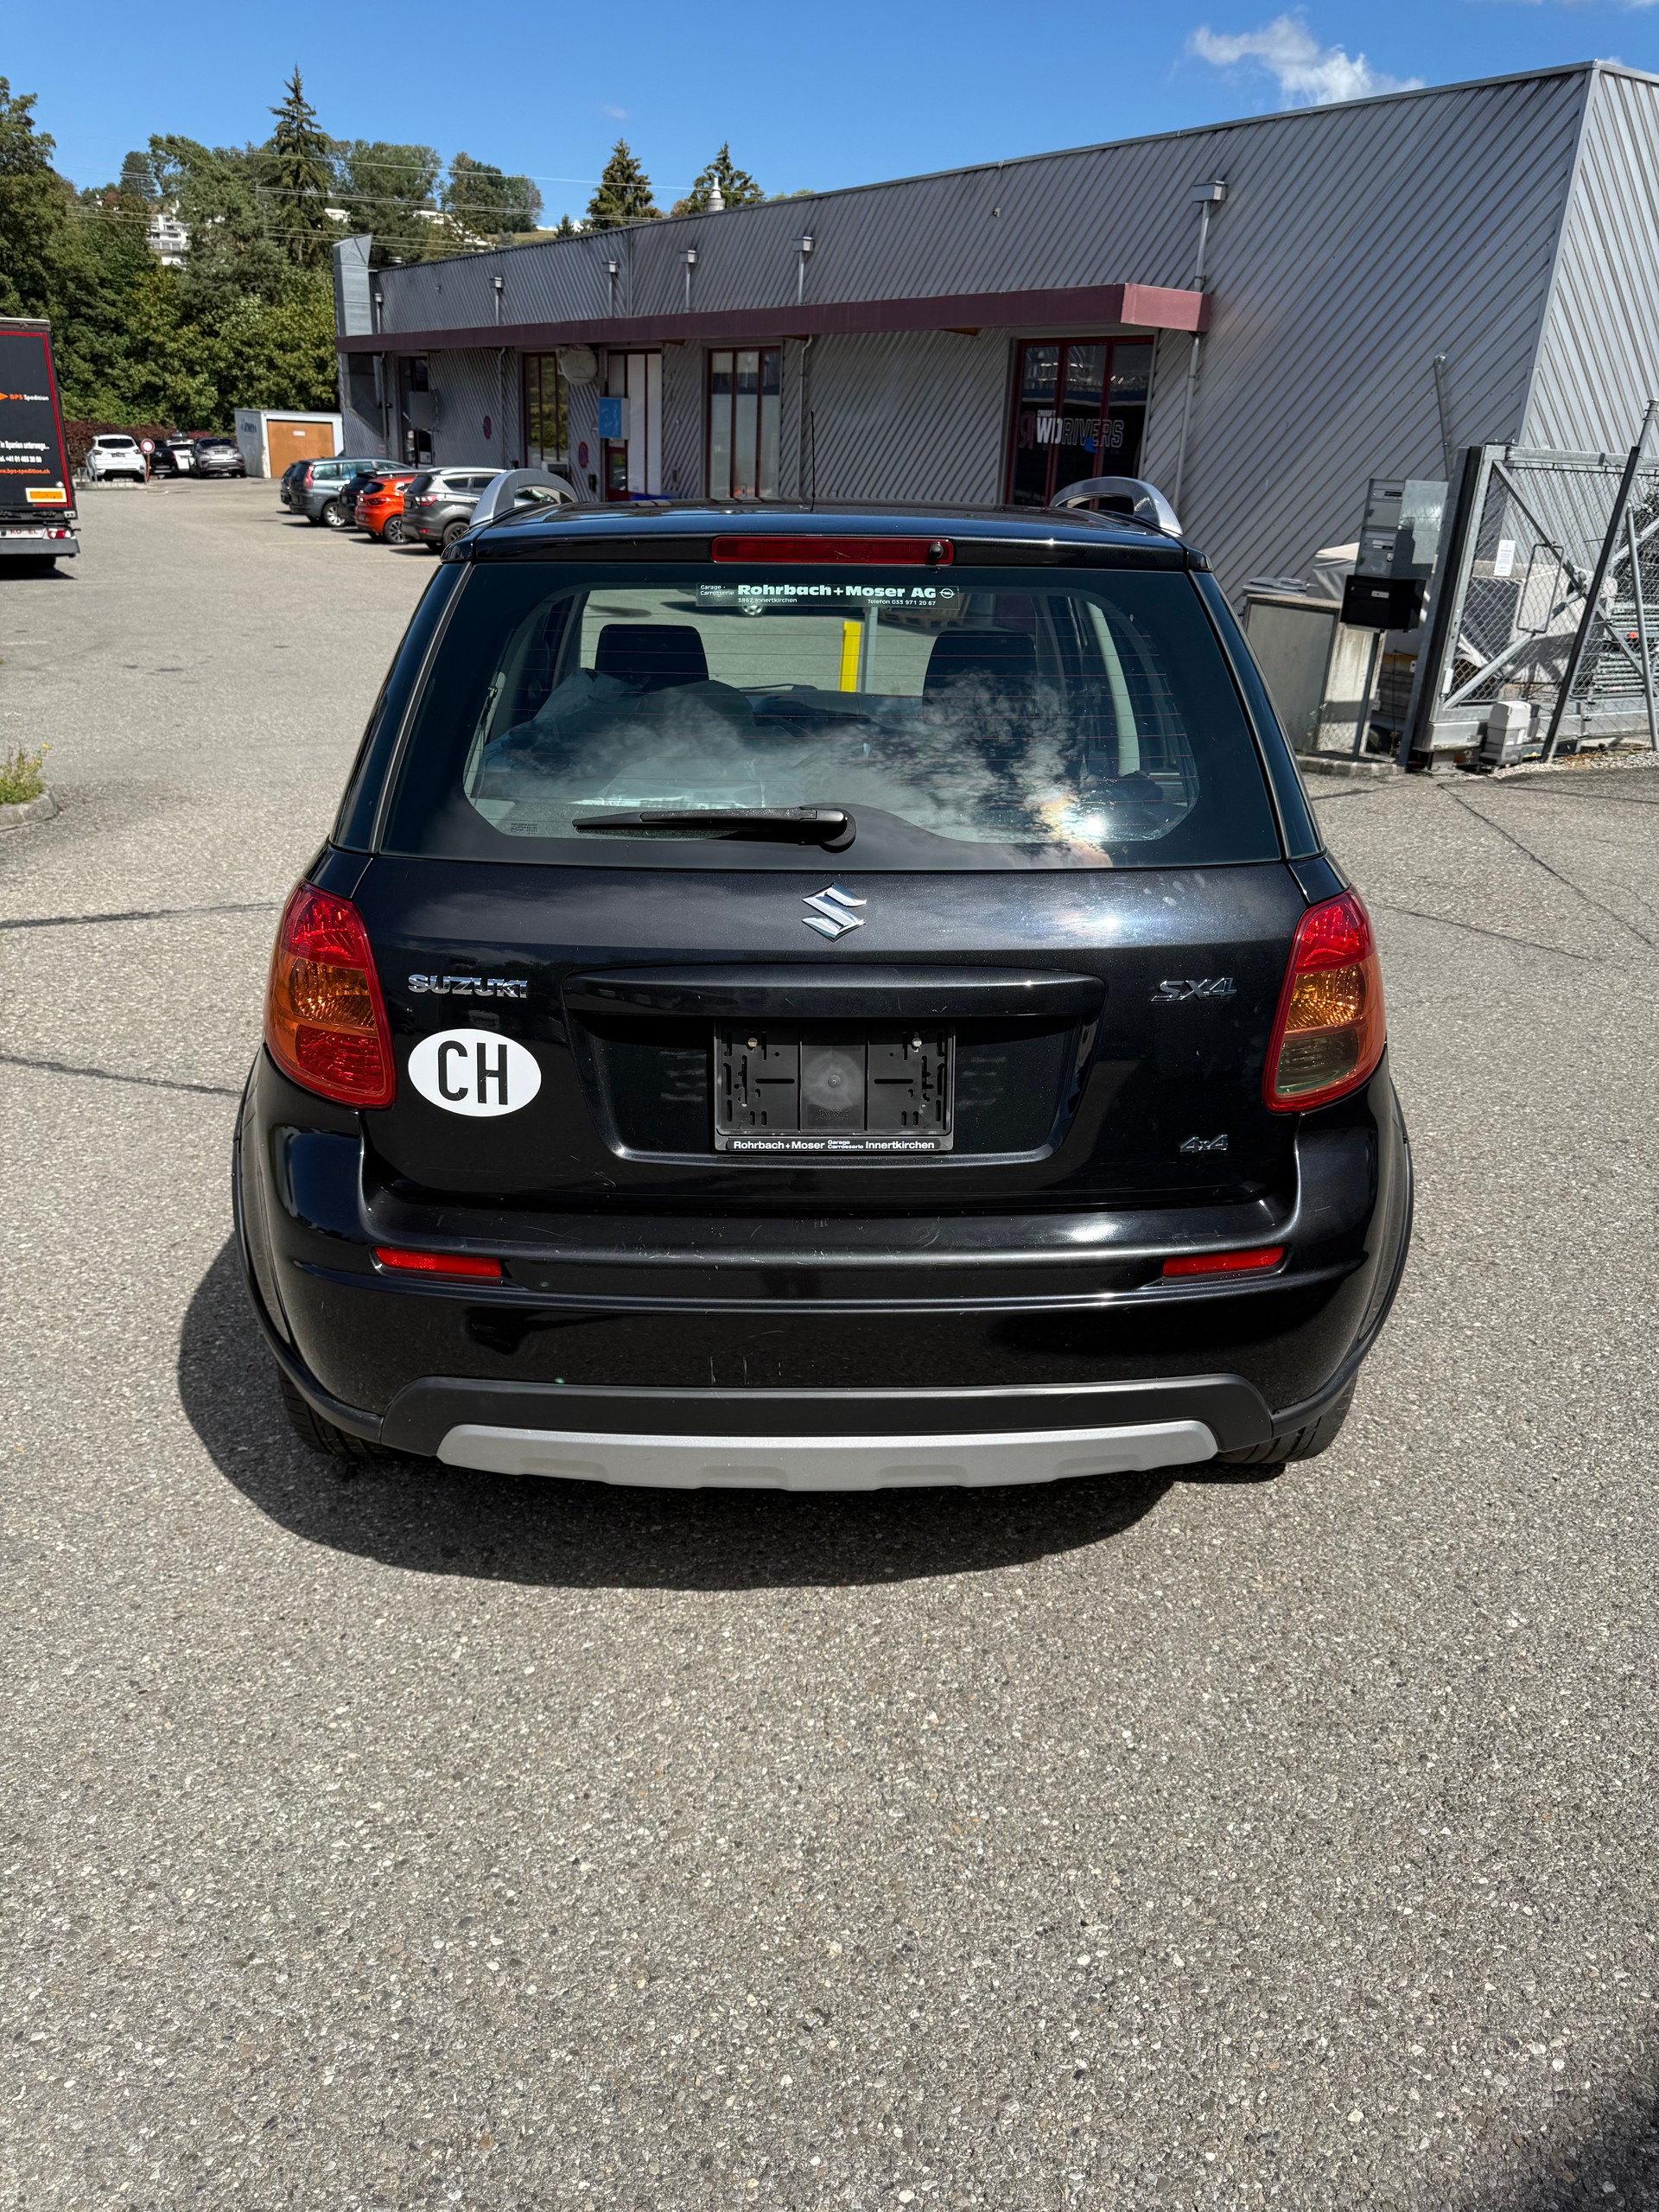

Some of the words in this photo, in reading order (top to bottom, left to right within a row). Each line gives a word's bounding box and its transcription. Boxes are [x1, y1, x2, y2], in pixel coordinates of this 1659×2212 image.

[23, 393, 49, 402] Spedition
[911, 588, 937, 598] AG
[408, 974, 528, 999] SUZUKI
[1151, 977, 1237, 1001] SX4
[437, 1040, 508, 1105] CH
[734, 1141, 825, 1149] Rohrbach+Moser
[865, 1141, 935, 1149] Innertkirchen
